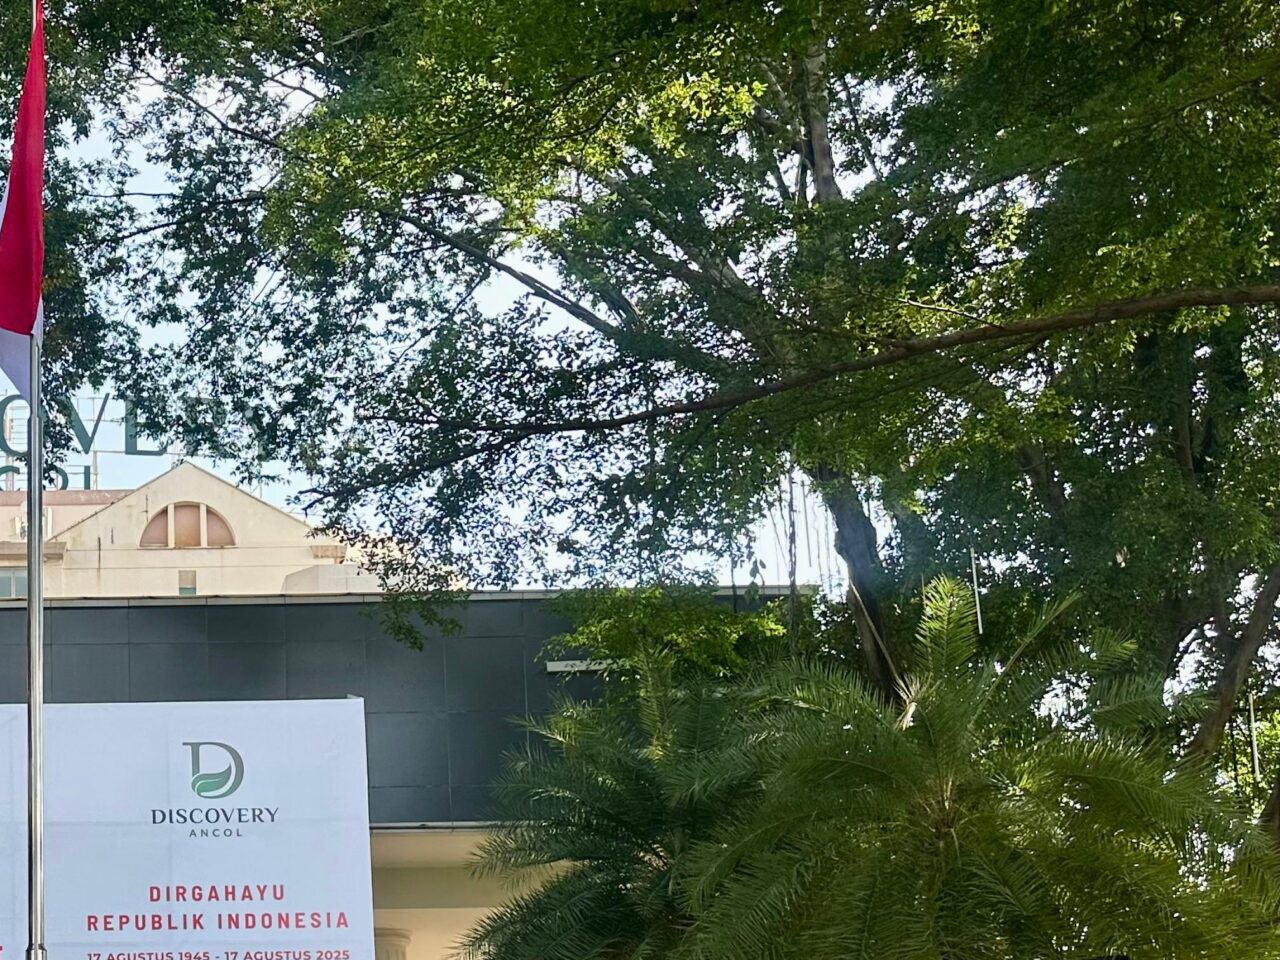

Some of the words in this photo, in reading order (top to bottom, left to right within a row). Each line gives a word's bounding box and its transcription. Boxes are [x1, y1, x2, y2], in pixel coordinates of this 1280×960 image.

[150, 807, 279, 825] DISCOVERY
[189, 828, 243, 838] ANCOL
[148, 884, 285, 902] DIRGAHAYU
[87, 913, 205, 931] REPUBLIK
[218, 911, 349, 930] INDONESIA
[243, 950, 311, 960] AGUSTUS
[316, 950, 350, 960] 2025
